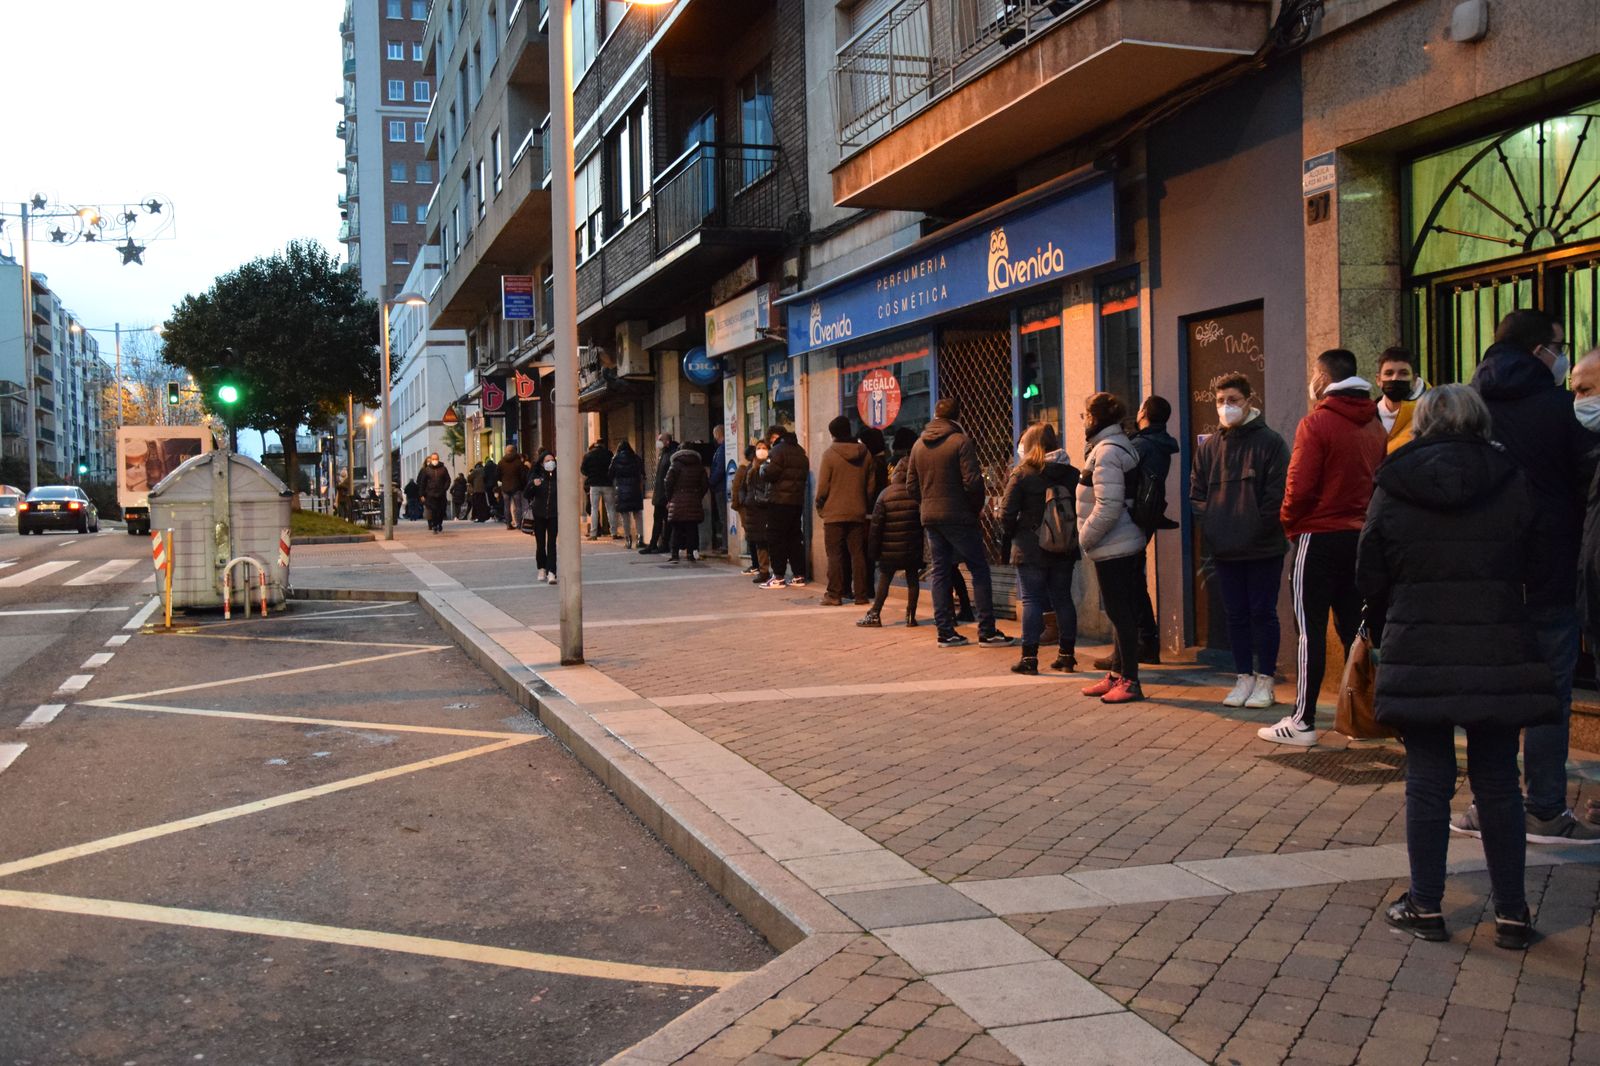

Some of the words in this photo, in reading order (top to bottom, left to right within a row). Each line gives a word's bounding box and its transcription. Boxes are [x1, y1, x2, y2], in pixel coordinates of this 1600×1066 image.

[877, 284, 948, 319] COSMÉTICA
[769, 359, 788, 377] DIGI
[862, 376, 895, 392] REGALO
